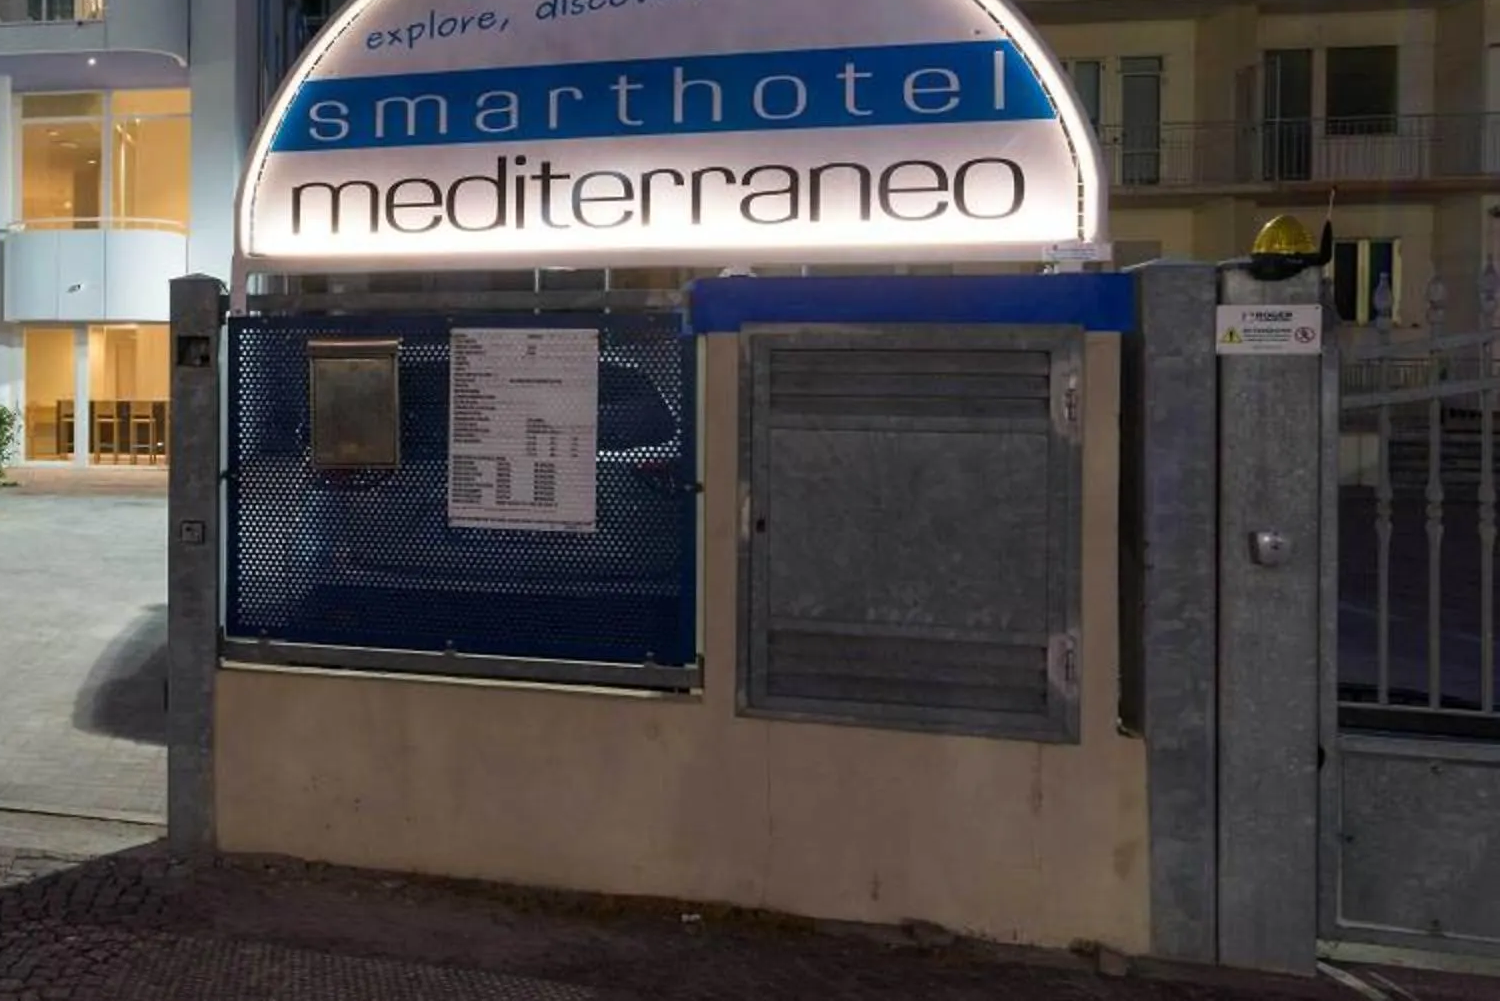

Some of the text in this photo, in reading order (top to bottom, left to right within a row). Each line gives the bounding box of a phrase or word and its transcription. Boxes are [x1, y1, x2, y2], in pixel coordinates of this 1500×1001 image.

[366, 6, 509, 51] explore,
[308, 50, 1006, 142] smarthotel
[292, 154, 1025, 235] mediterraneo
